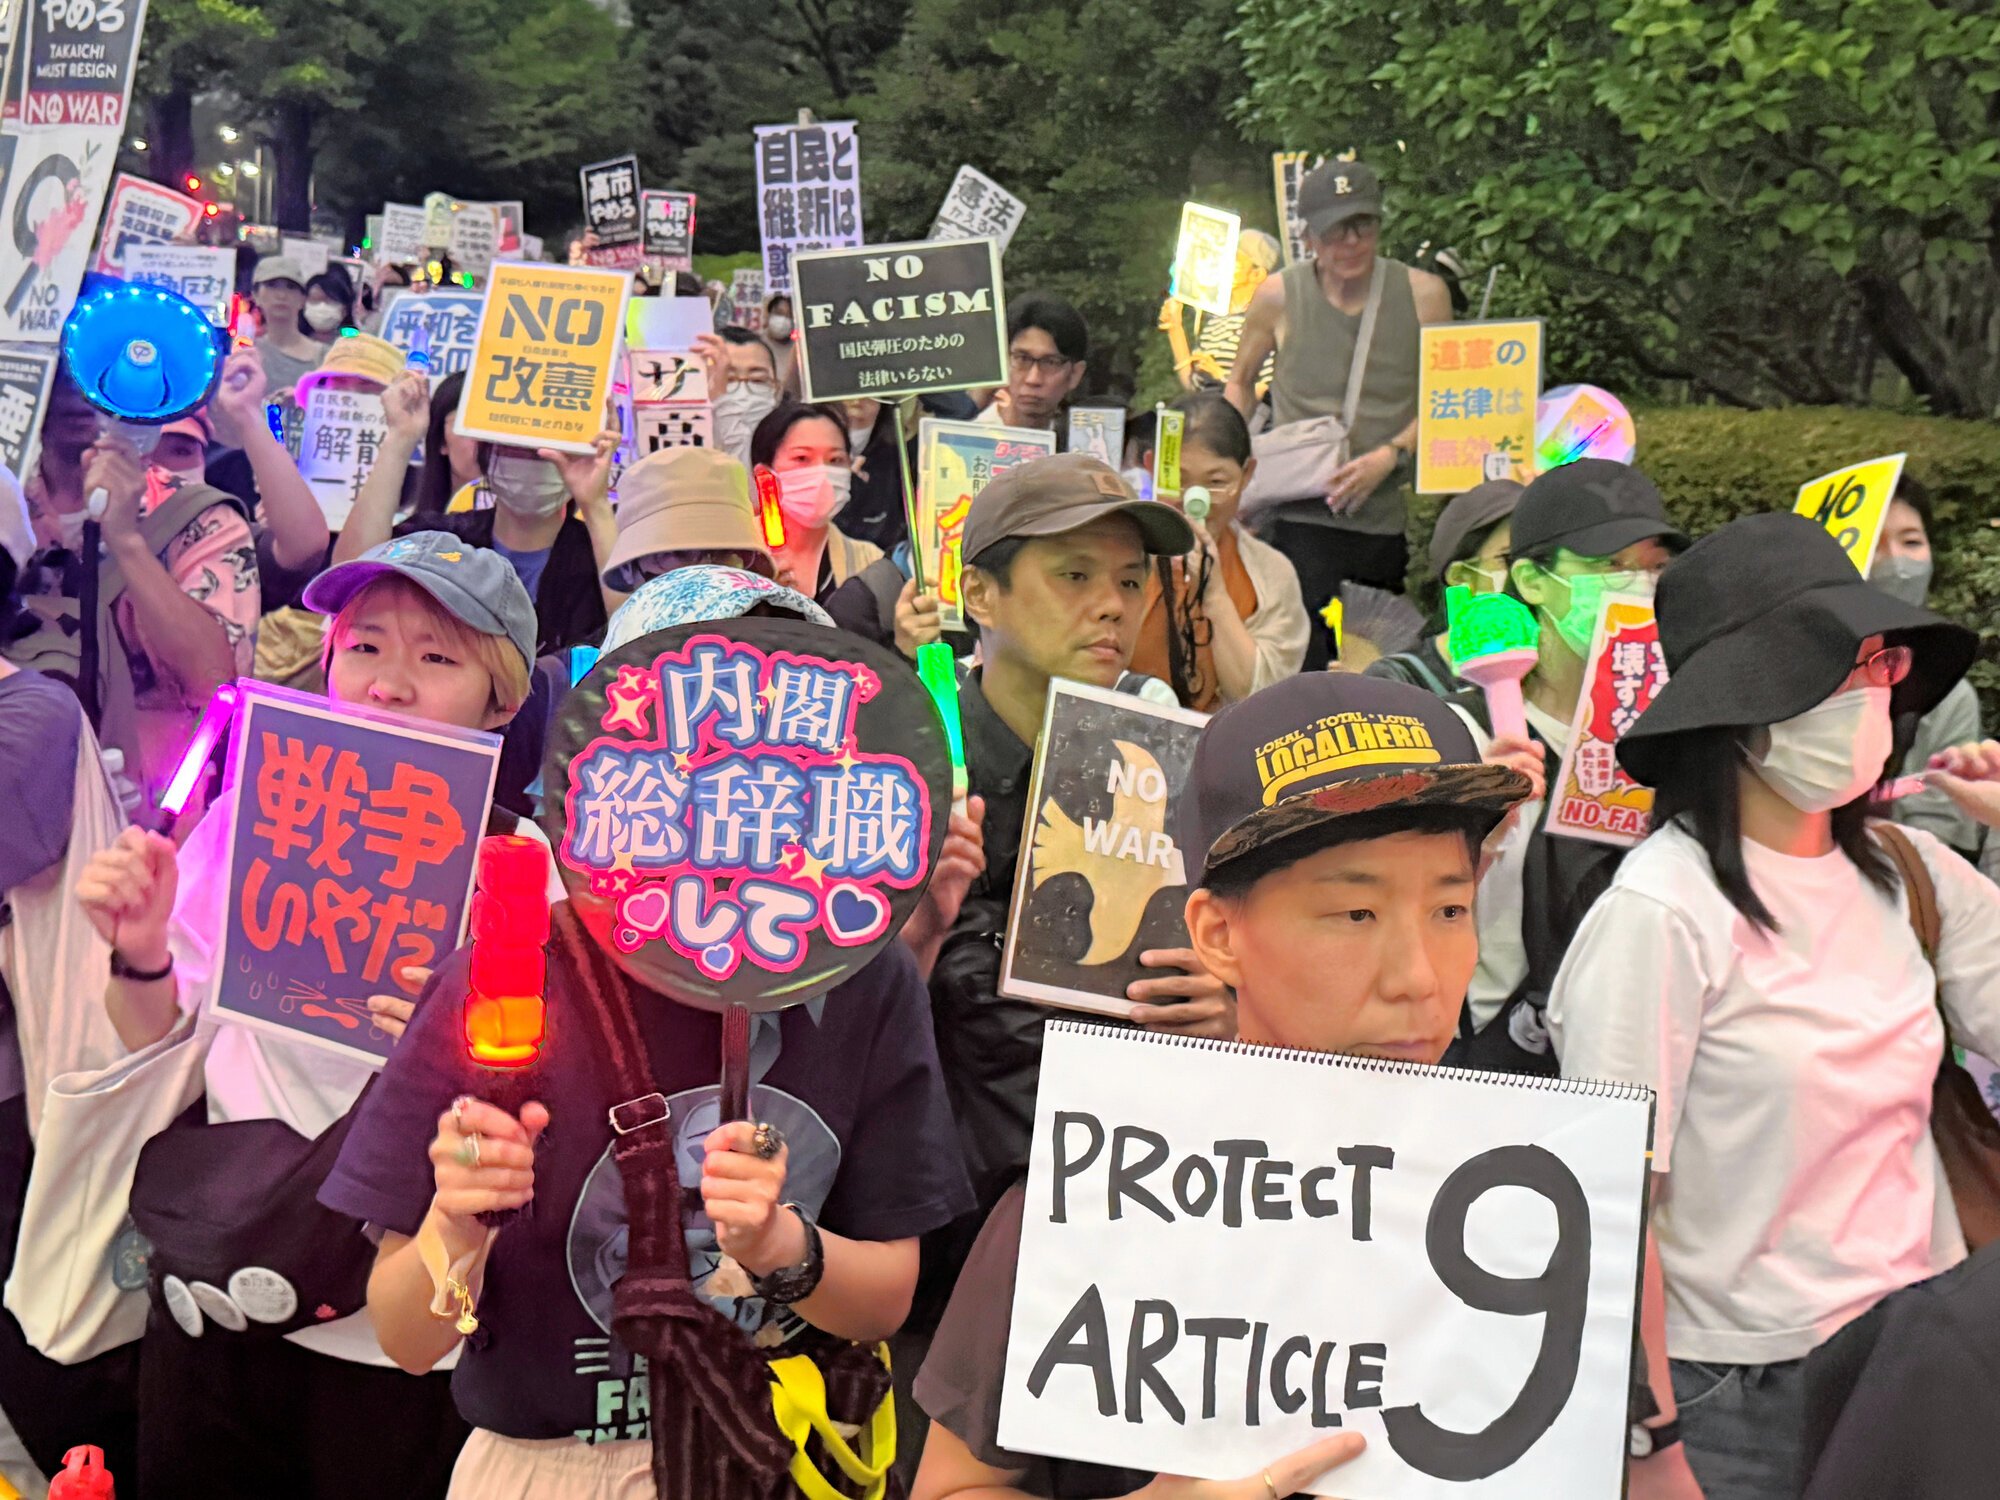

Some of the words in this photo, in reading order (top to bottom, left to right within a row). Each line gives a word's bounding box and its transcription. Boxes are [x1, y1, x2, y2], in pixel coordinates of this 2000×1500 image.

[36, 63, 66, 78] MUST
[69, 63, 118, 79] RESIGN
[50, 44, 105, 59] TAKAICHI
[27, 94, 64, 124] NO
[67, 95, 119, 125] WAR
[1334, 176, 1352, 194] R
[863, 255, 923, 282] NO
[29, 284, 59, 307] NO
[806, 288, 992, 328] FACISM
[19, 309, 60, 331] WAR
[500, 294, 604, 346] NO
[486, 355, 596, 411] 改憲
[858, 365, 952, 388] 法律いらない
[1430, 387, 1524, 420] 法律は
[1814, 475, 1866, 526] NO
[666, 650, 853, 750] 内閣
[1255, 729, 1304, 758] LOKAL
[1316, 712, 1367, 729] TOTAL
[1378, 714, 1425, 727] LOYAL
[1256, 723, 1433, 788] LOCALHERO
[1106, 759, 1166, 803] NO
[254, 731, 466, 889] 戦争
[580, 755, 914, 870] 総辞職
[1564, 800, 1600, 825] NO
[1083, 816, 1174, 869] WAR
[241, 857, 447, 996] いやだ
[674, 880, 813, 957] して
[1049, 1110, 1394, 1241] PROTECT
[1027, 1283, 1387, 1428] ARTICLE
[1380, 1143, 1591, 1482] 9
